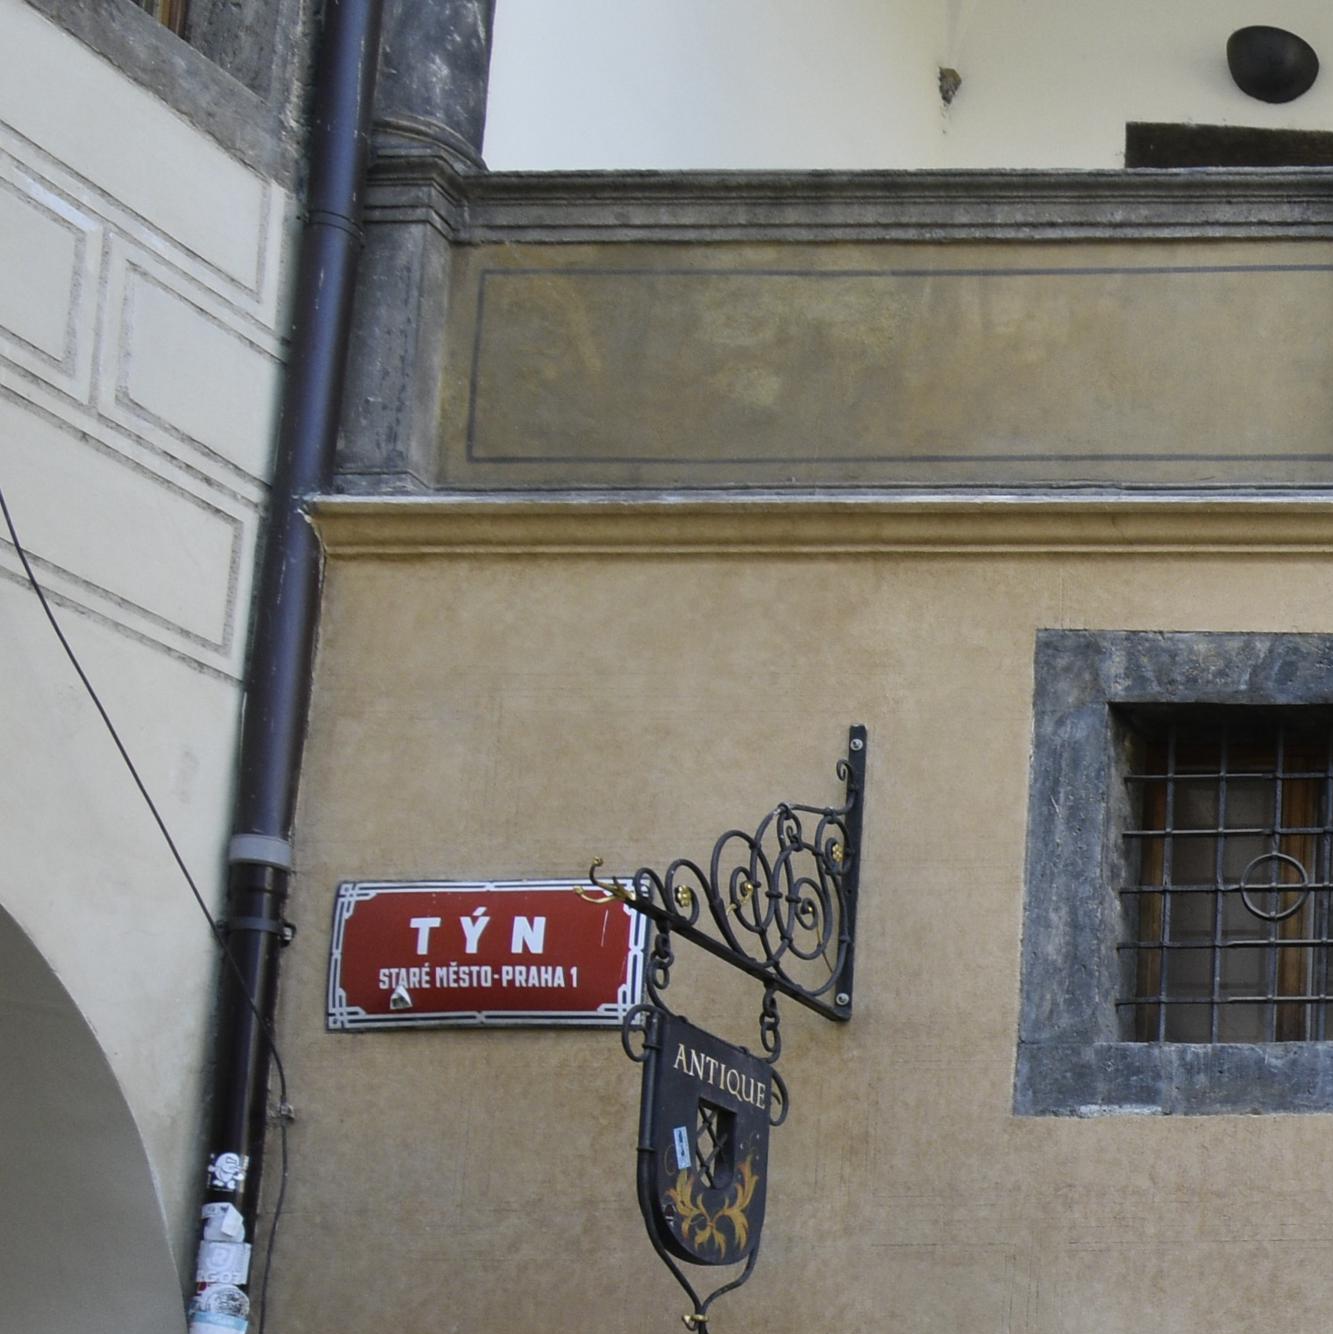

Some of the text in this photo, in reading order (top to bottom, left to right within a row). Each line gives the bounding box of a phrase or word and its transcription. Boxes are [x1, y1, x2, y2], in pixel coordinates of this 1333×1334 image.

[409, 906, 546, 955] TÝN
[378, 964, 431, 990] STARÉ
[570, 968, 579, 988] 1
[673, 1043, 766, 1110] ANTIQUE
